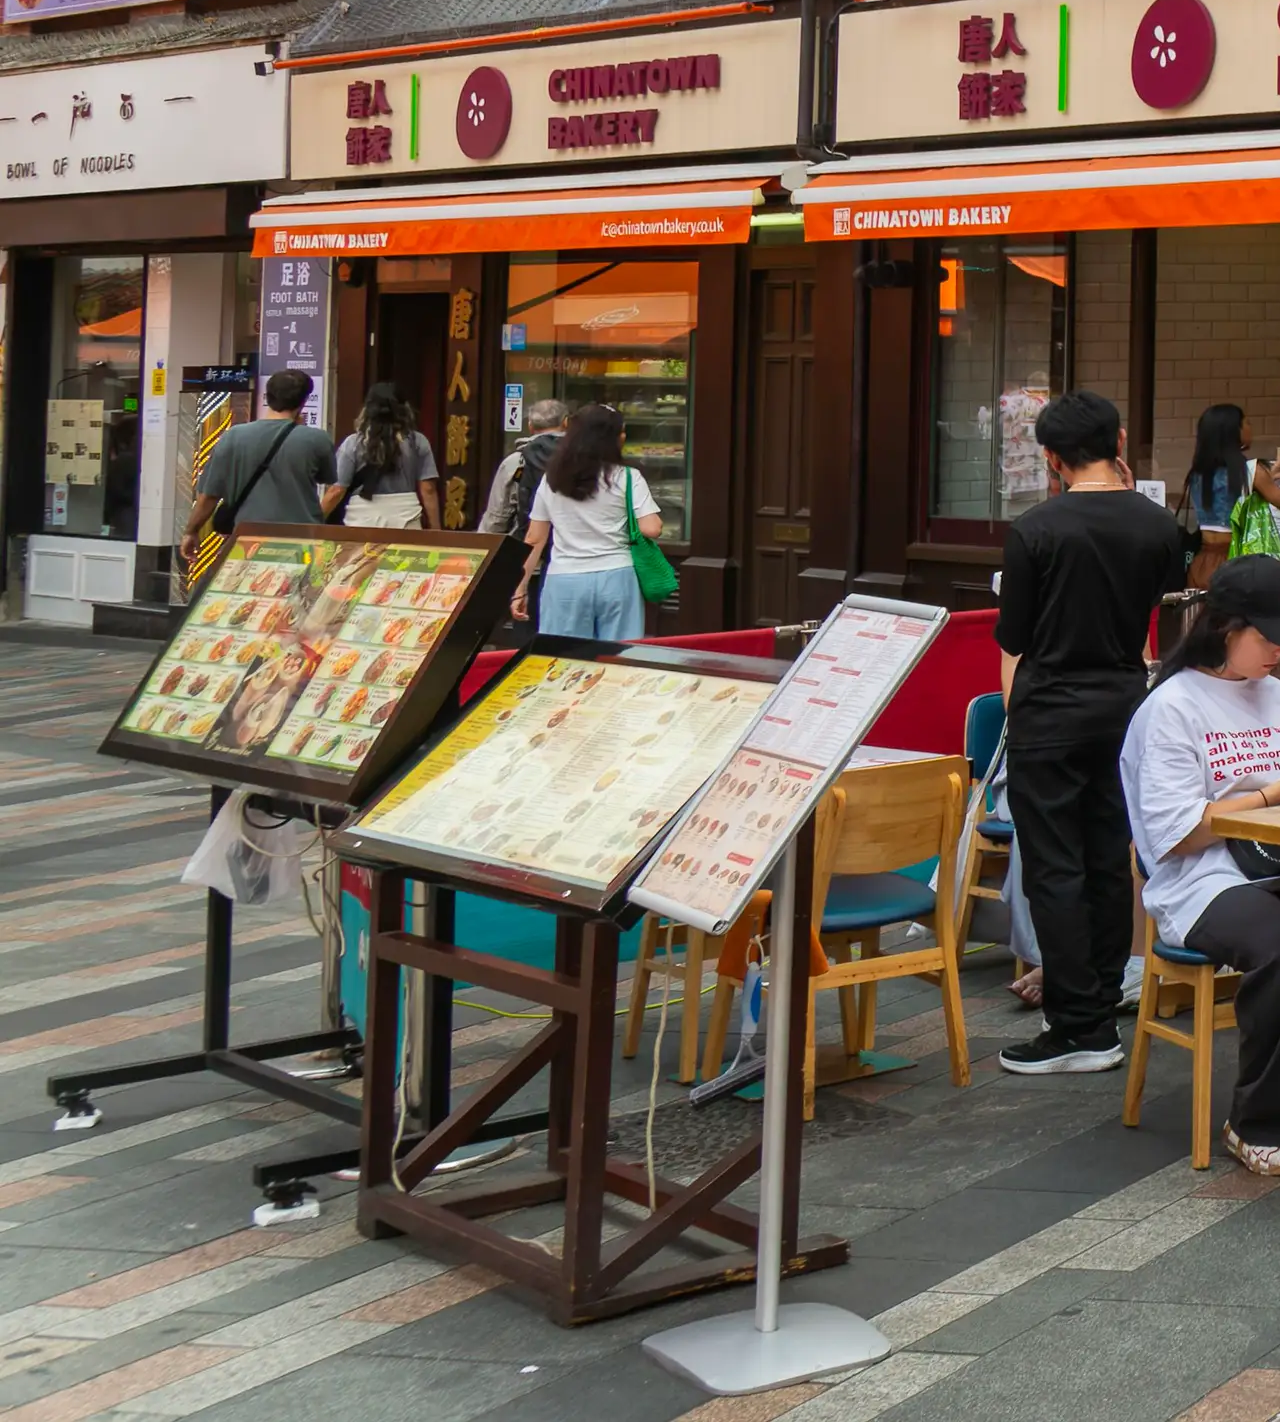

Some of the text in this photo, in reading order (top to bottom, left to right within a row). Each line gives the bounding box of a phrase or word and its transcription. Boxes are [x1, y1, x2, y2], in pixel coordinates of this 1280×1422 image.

[958, 12, 1027, 64] 唐人
[549, 54, 721, 103] CHINATOWN
[347, 79, 391, 119] 唐人
[548, 109, 659, 150] BAKERY
[7, 153, 135, 179] BOWL OF NOODLES
[854, 208, 944, 230] CHINATOWN
[948, 205, 1012, 227] BAKERY
[289, 233, 345, 250] CHINATOWN
[348, 232, 389, 249] BAKERY
[281, 262, 310, 287] 足浴
[270, 291, 319, 304] FOOT BATH
[286, 305, 319, 318] massage
[1205, 730, 1228, 744] I'm
[1229, 726, 1272, 741] boring
[1208, 742, 1229, 756] all
[1256, 739, 1269, 749] is
[1209, 753, 1255, 770] make
[1213, 771, 1226, 782] &
[1233, 763, 1271, 777] come
